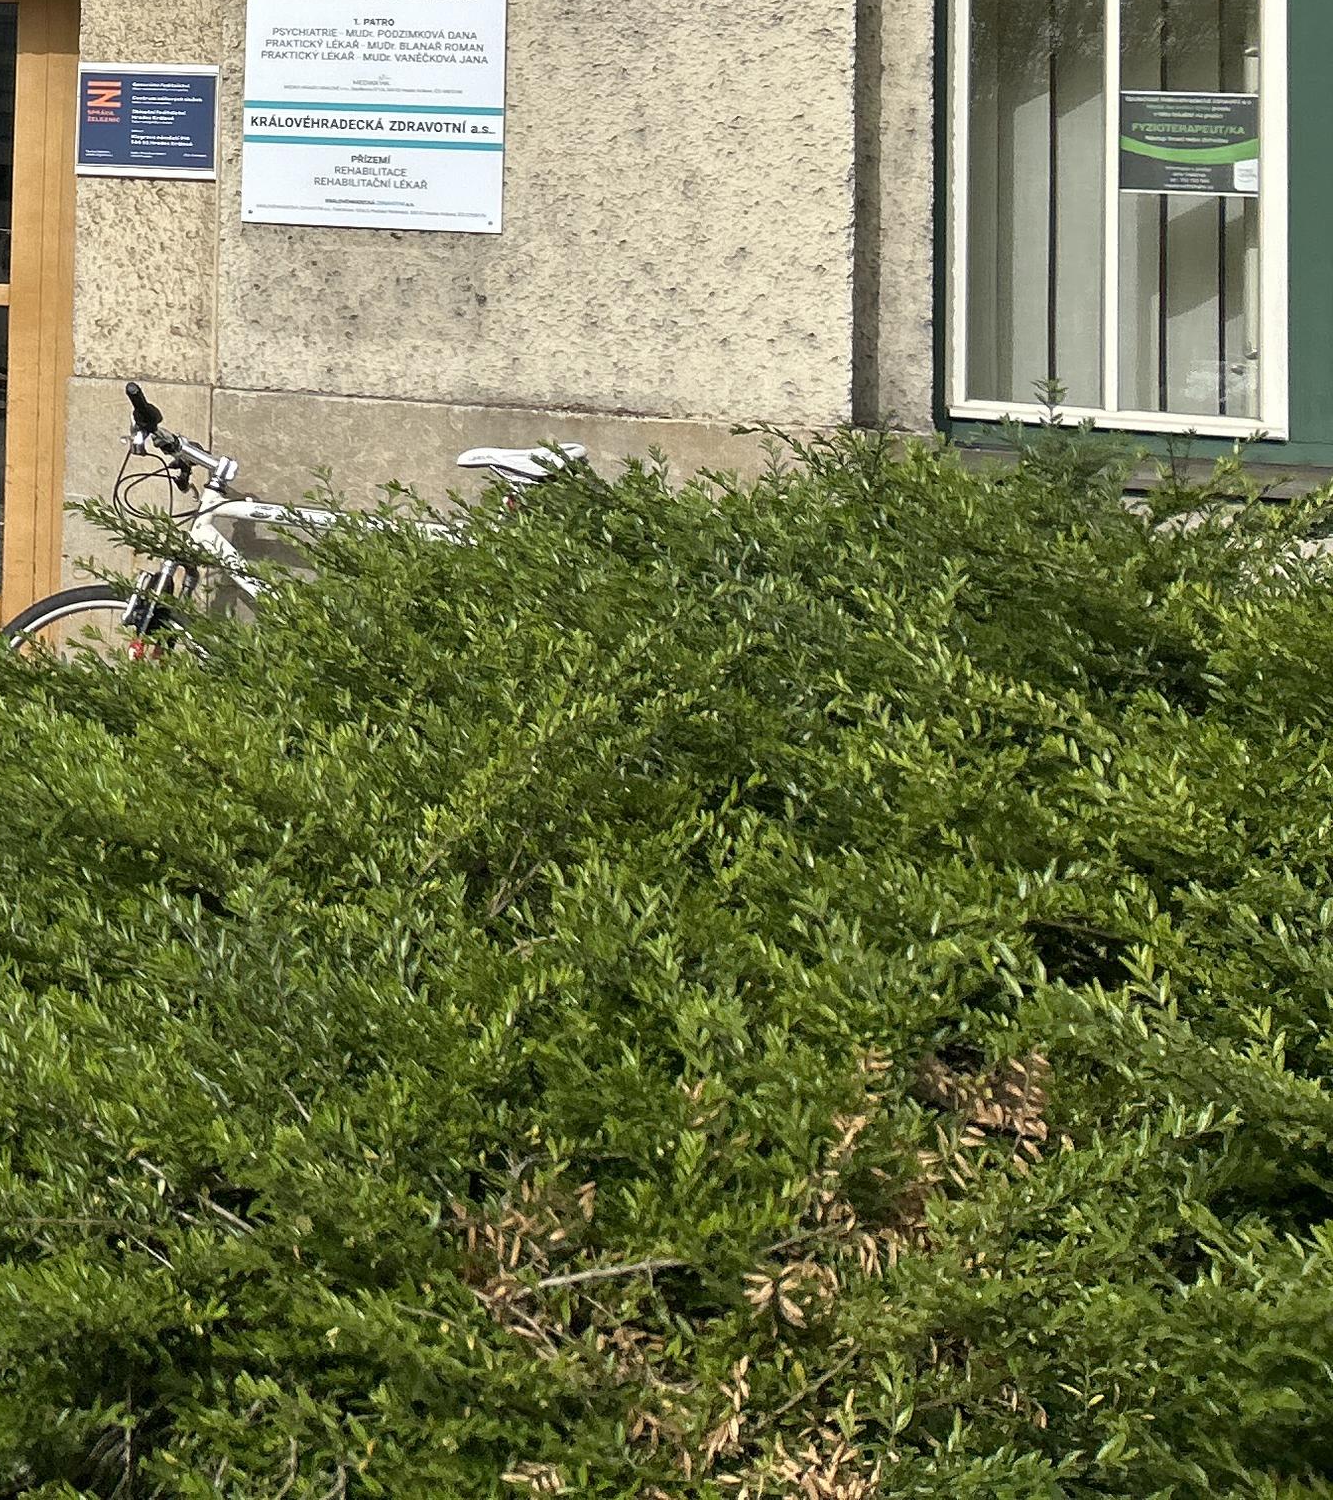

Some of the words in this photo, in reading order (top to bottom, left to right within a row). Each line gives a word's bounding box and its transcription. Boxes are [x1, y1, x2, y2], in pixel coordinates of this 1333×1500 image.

[363, 18, 395, 26] PATRO
[272, 27, 338, 37] PSYCHIATRIE
[377, 29, 445, 39] PODZIMKOVÁ
[447, 31, 478, 40] DANA
[265, 39, 323, 48] PRAKTICKÝ
[326, 39, 359, 49] LÉKAŘ
[444, 43, 484, 52] ROMAN
[261, 50, 319, 60] PRAKTICKÝ
[321, 51, 355, 61] LÉKAŘ
[394, 53, 457, 63] VANĚČKOVÁ
[459, 56, 488, 64] JANA
[251, 115, 384, 131] KRÁLOVÉHRADECKÁ
[389, 120, 466, 134] ZDRAVOTNÍ
[1132, 122, 1245, 134] FYZIOTERAPEUT/KA
[351, 154, 391, 164] PŘÍZEMÍ
[334, 166, 407, 177] REHABILITACE
[314, 177, 391, 188] REHABILITAČNÍ
[393, 179, 428, 190] LÉKAŘ
